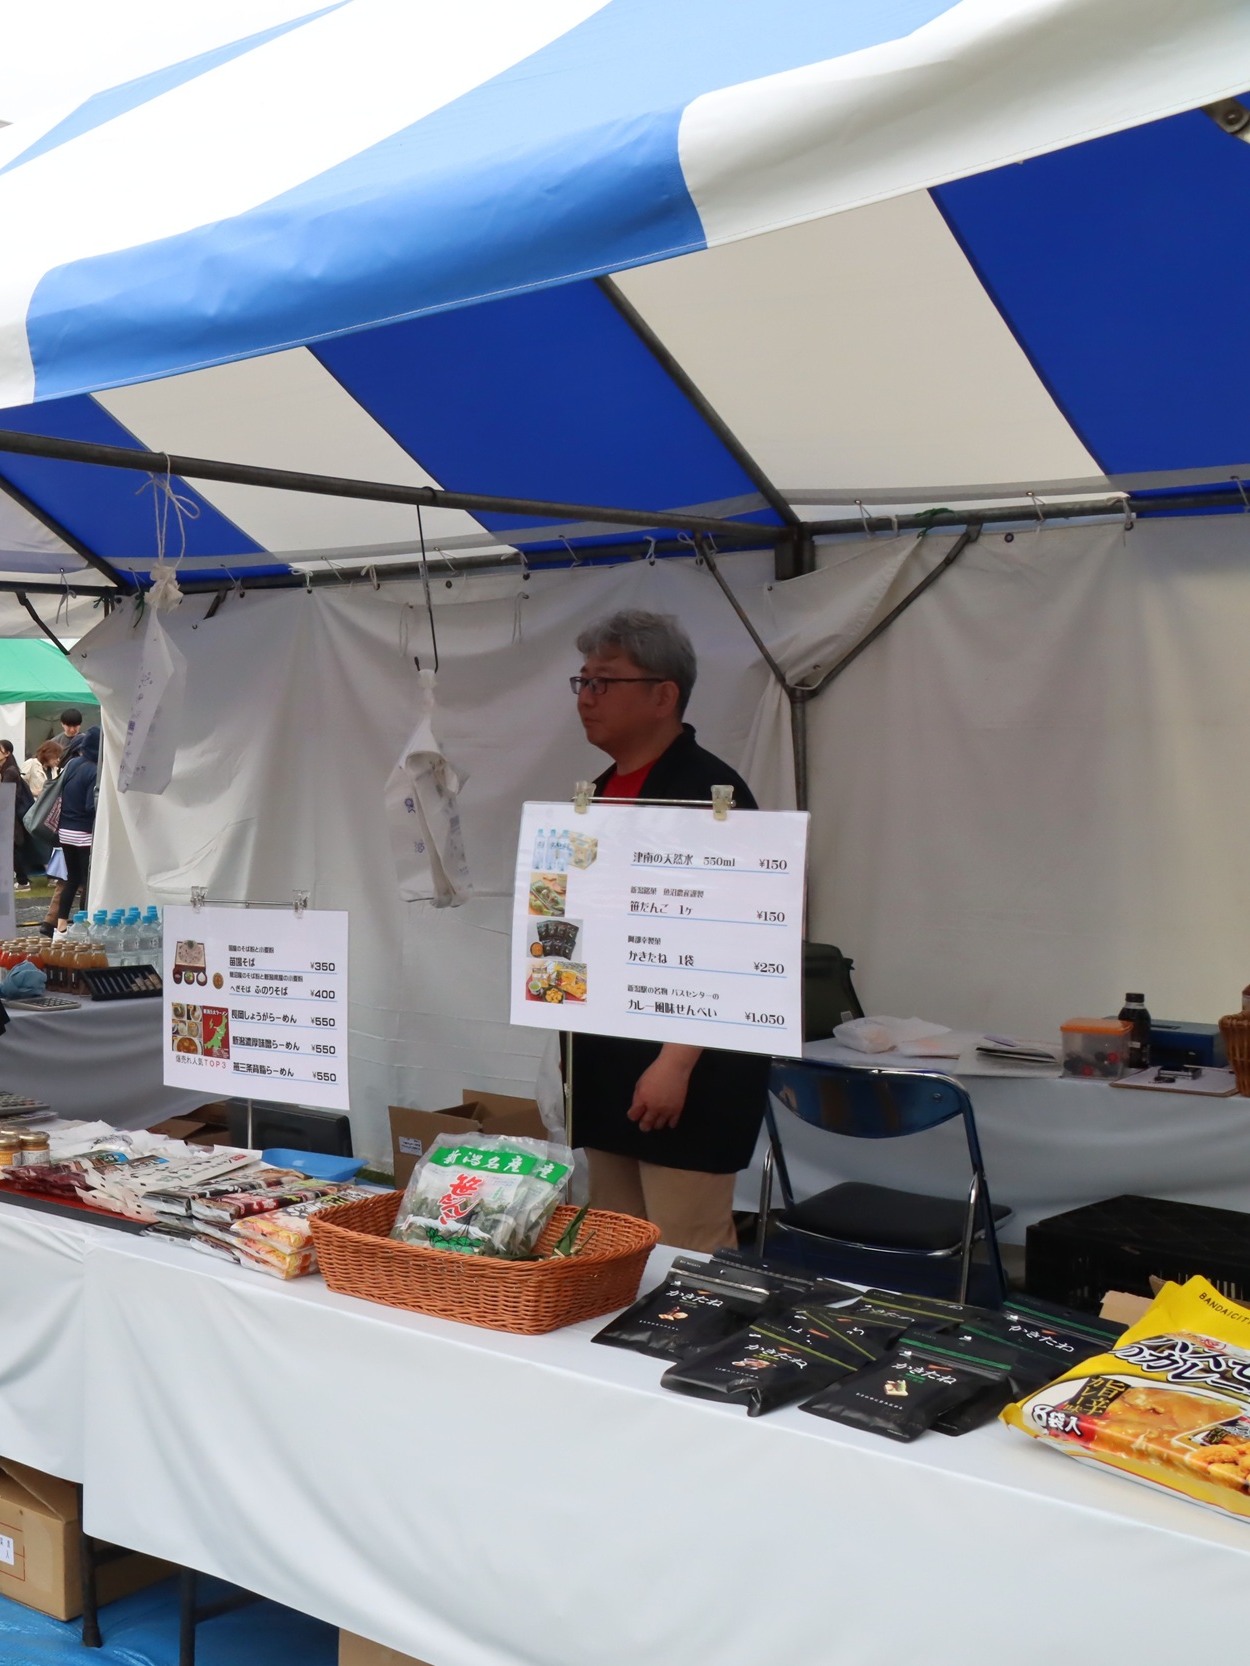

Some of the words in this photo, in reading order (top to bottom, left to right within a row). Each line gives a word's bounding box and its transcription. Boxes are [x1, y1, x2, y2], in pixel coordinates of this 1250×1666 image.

[633, 851, 693, 865] 津南の天然水
[703, 856, 736, 867] 550ml
[759, 859, 787, 870] ¥150
[630, 901, 669, 914] 笹だんご
[757, 911, 785, 922] ¥150
[310, 962, 336, 971] ¥350
[628, 951, 668, 964] かきたね
[754, 962, 785, 974] ¥250
[230, 985, 251, 993] へぎそば
[254, 986, 288, 996] ふのりそば
[310, 990, 336, 999] ¥400
[627, 984, 668, 996] 新潟駅の名物
[671, 988, 720, 1000] バスセンターの
[628, 999, 717, 1017] カレー風味せんべい
[231, 1009, 297, 1024] 長岡しょうがらーめん
[310, 1017, 335, 1027] ¥550
[311, 1044, 336, 1054] ¥550
[312, 1071, 337, 1081] ¥550
[443, 1149, 525, 1173] 新潟名産
[666, 1290, 724, 1307] かきたね
[1008, 1325, 1075, 1353] かきたね
[744, 1344, 808, 1369] かきたね
[891, 1362, 957, 1385] かきたね
[1083, 1379, 1126, 1415] 旨辛
[1032, 1403, 1083, 1436] 8袋入
